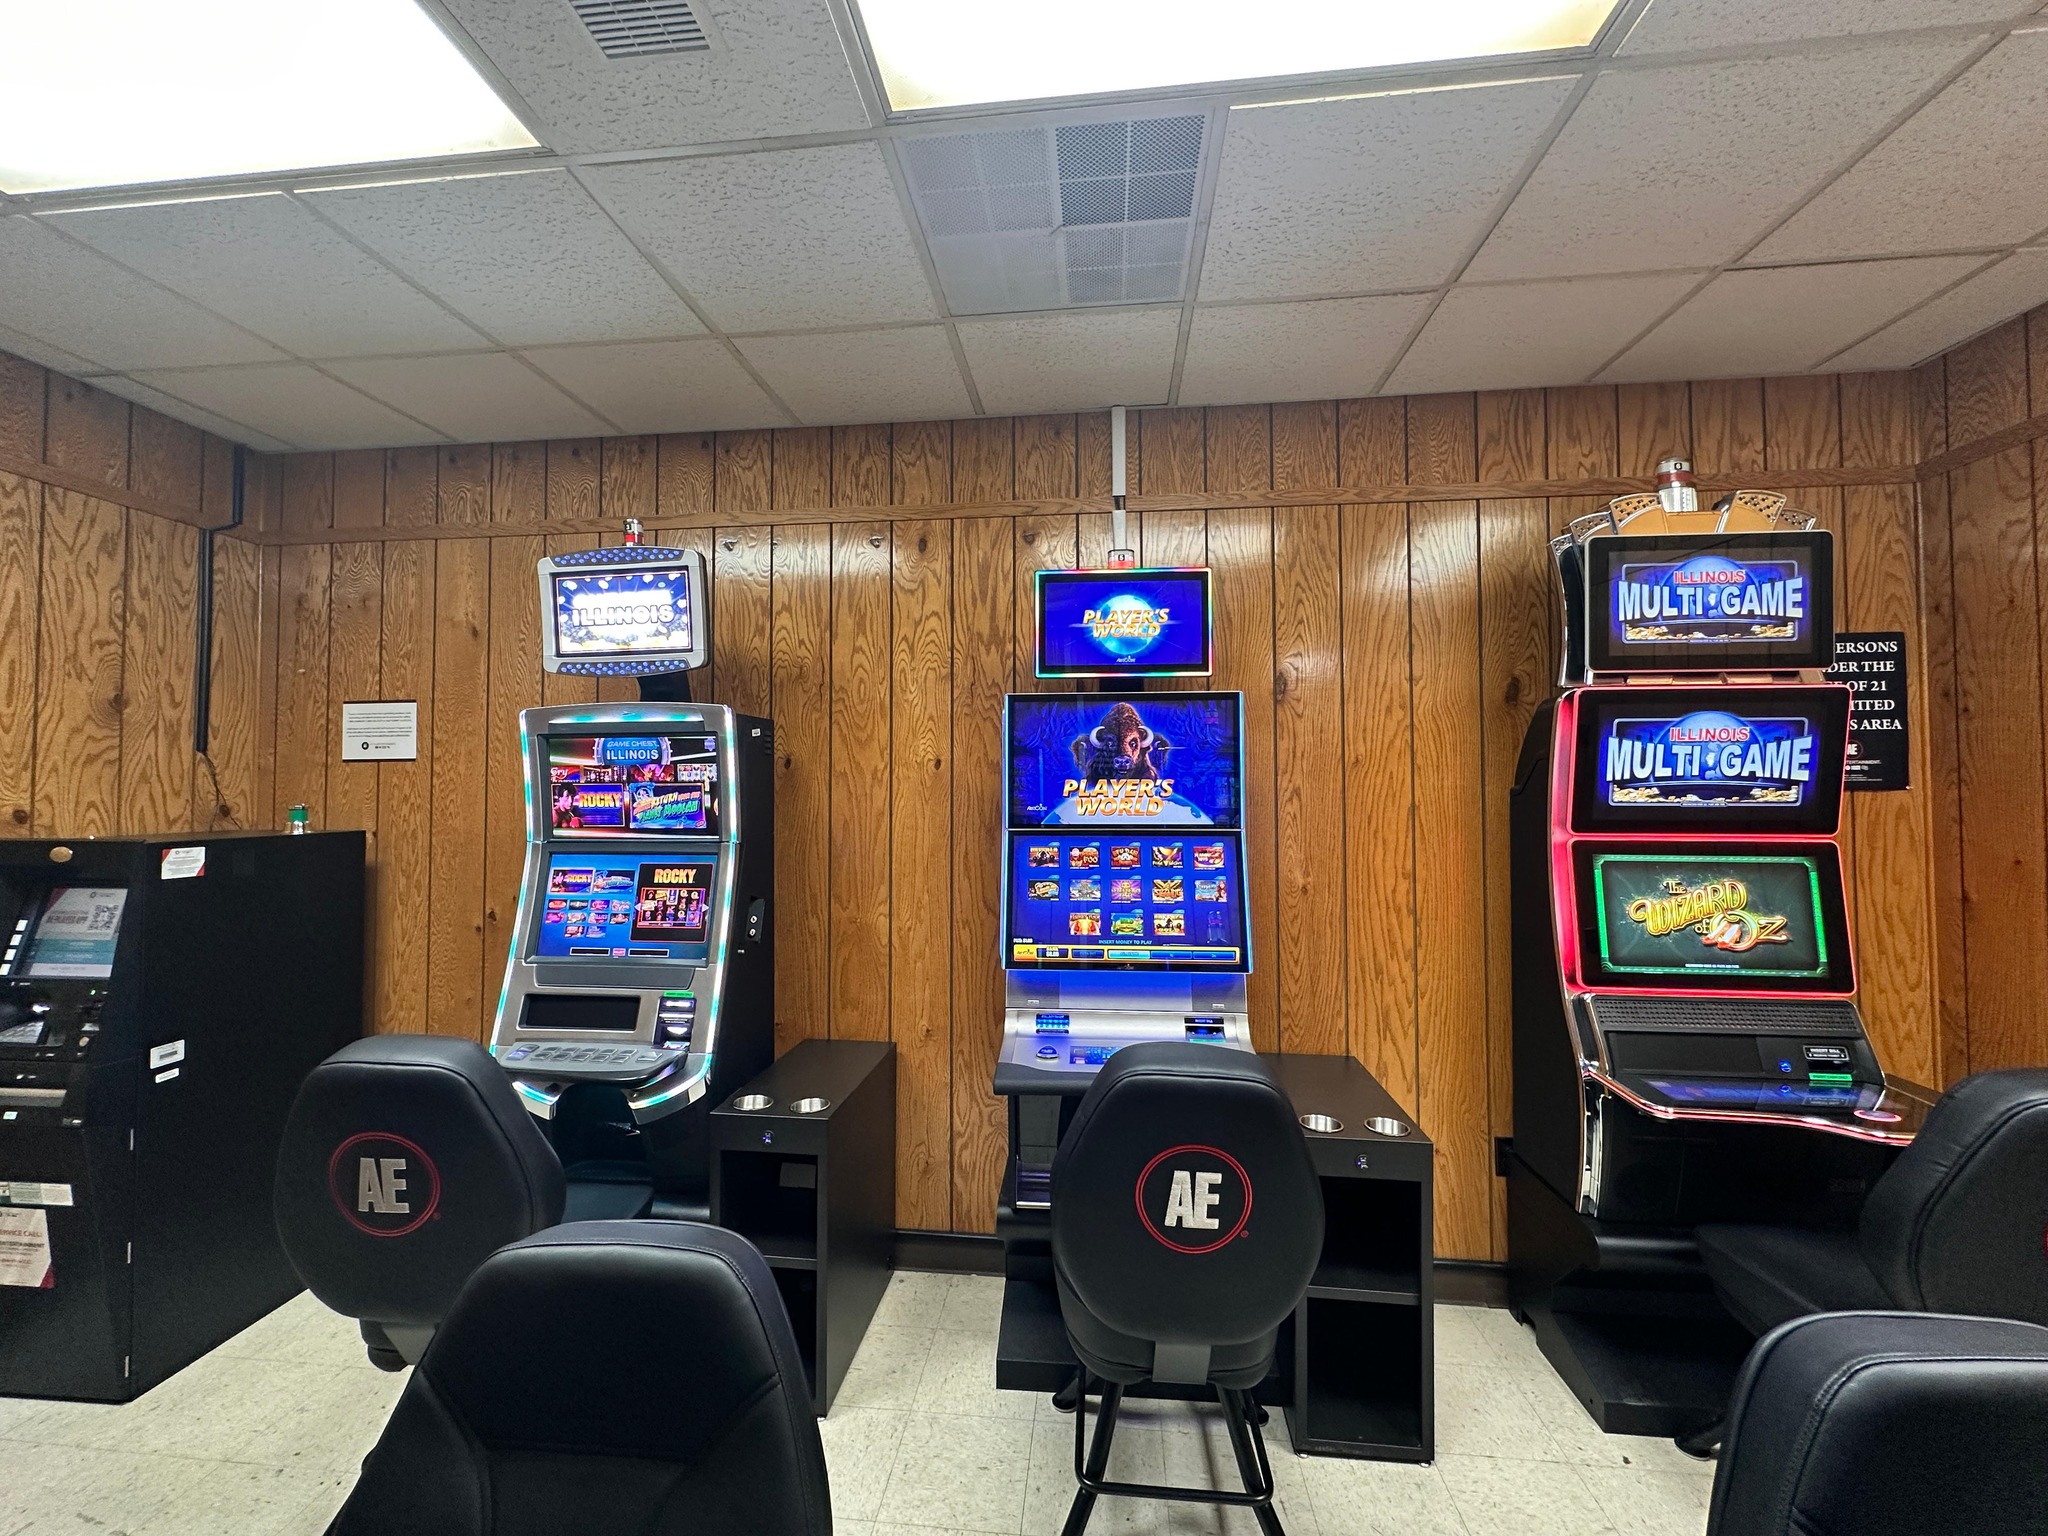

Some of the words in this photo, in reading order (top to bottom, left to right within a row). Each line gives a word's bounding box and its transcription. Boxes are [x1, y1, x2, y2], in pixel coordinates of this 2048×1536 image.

[1673, 570, 1746, 585] ILLINOIS
[1618, 580, 1703, 621] MULTI
[1720, 577, 1803, 619] GAME
[572, 604, 675, 627] ILLINOIS
[1083, 608, 1170, 624] PLAYER'S
[1092, 623, 1161, 638] WORLD
[1836, 641, 1898, 654] ERSONS
[1823, 660, 1859, 673] DER
[1861, 660, 1896, 672] THE
[1847, 680, 1867, 692] OF
[1870, 680, 1887, 692] 21
[1849, 699, 1895, 711] ITTED
[1860, 718, 1903, 730] AREA
[1669, 726, 1750, 742] ILLINOIS
[607, 740, 631, 748] GAME
[606, 749, 659, 760] ILLINOIS
[1606, 736, 1701, 782] MULTI
[1719, 736, 1813, 782] GAME
[1063, 778, 1175, 798] PLAYER'S
[579, 791, 621, 809] ROCKY
[1075, 797, 1165, 817] WORLD
[654, 868, 697, 884] ROCKY
[1663, 880, 1687, 894] The
[1694, 918, 1711, 935] of
[358, 1157, 410, 1214] AE
[1164, 1170, 1223, 1230] AE
